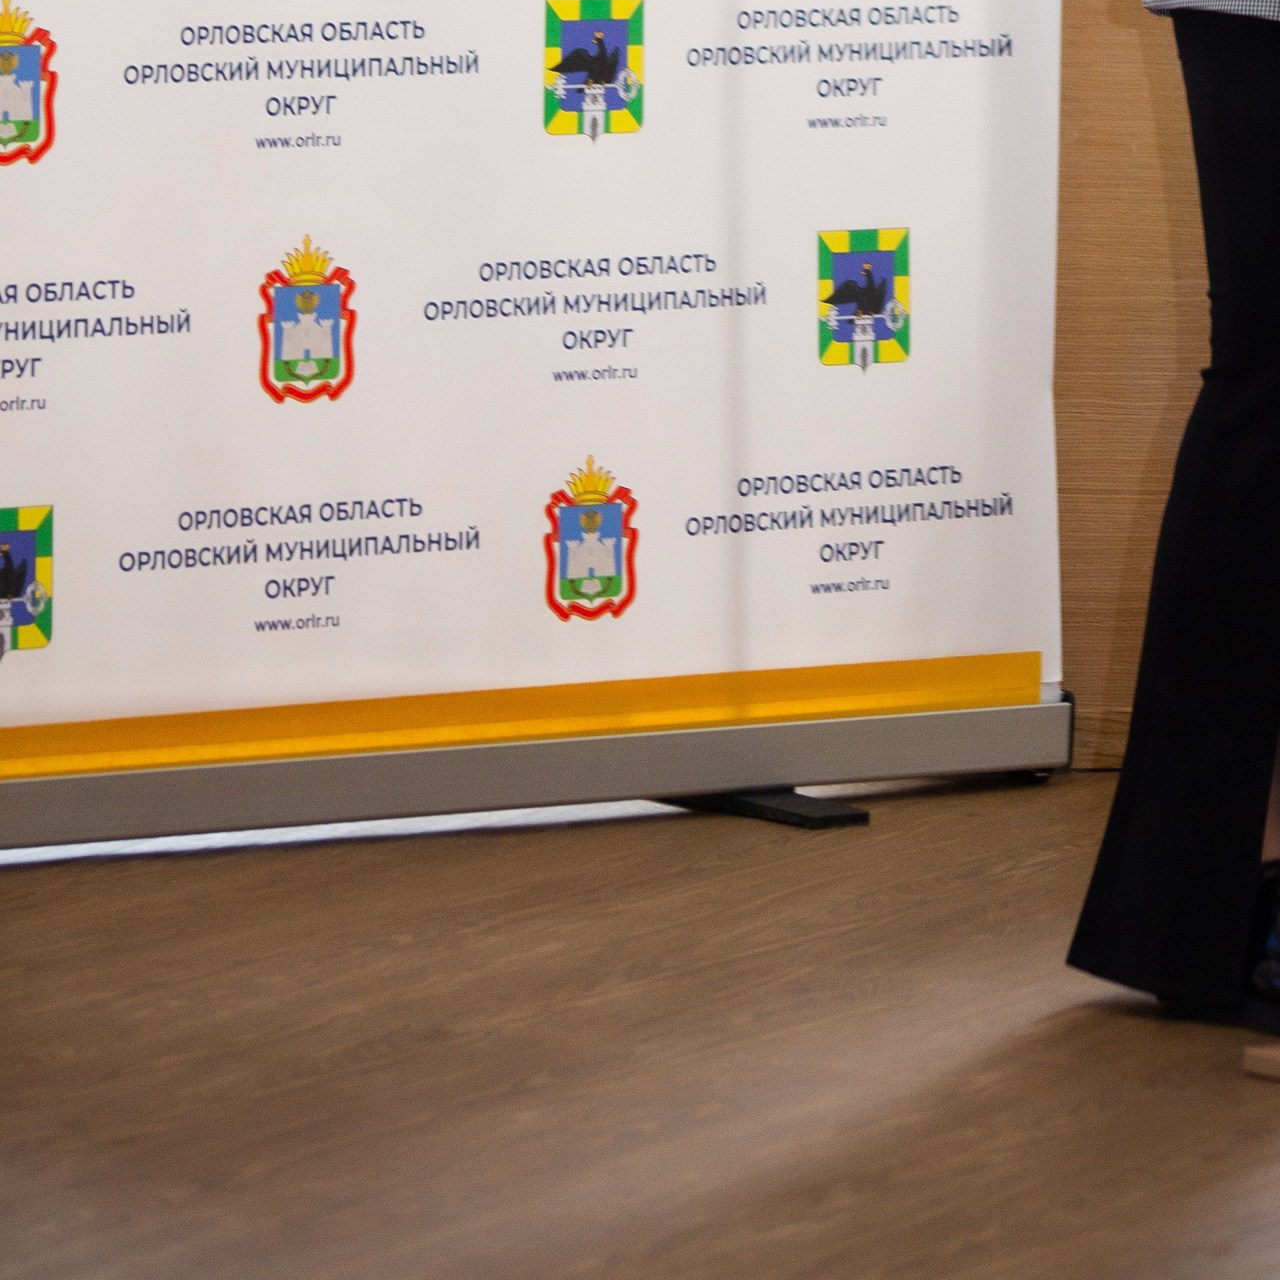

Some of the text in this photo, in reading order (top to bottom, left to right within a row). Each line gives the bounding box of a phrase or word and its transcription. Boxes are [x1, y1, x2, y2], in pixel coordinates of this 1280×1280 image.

[735, 4, 960, 31] ОРЛОВСКАЯ ОБЛАСТЬ
[179, 19, 426, 47] ОРЛОВСКАЯ ОБЛАСТЬ
[686, 32, 1014, 68] ОРЛОВСКИЙ МУНИЦИПАЛЬНЫЙ
[123, 48, 480, 86] ОРЛОВСКИЙ МУНИЦИПАЛЬНЫЙ
[815, 76, 884, 99] ОКРУГ
[264, 94, 338, 118] ОКРУГ
[478, 253, 718, 283] ОРЛОВСКАЯ ОБЛАСТЬ
[24, 279, 136, 304] ОБЛАСТЬ
[422, 281, 767, 322] ОРЛОВСКИЙ МУНИЦИПАЛЬНЫЙ
[0, 307, 192, 344] НИЦИПАЛЬНЫЙ
[561, 327, 635, 351] ОКРУГ
[0, 357, 43, 380] РУГ
[736, 465, 963, 498] ОРЛОВСКАЯ ОБЛАСТЬ
[177, 497, 424, 532] ОРЛОВСКАЯ ОБЛАСТЬ
[684, 491, 1014, 537] ОРЛОВСКИЙ МУНИЦИПАЛЬНЫЙ
[118, 524, 481, 573] ОРЛОВСКИЙ МУНИЦИПАЛЬНЫЙ
[818, 539, 886, 564] ОКРУГ
[263, 575, 336, 600] ОКРУГ
